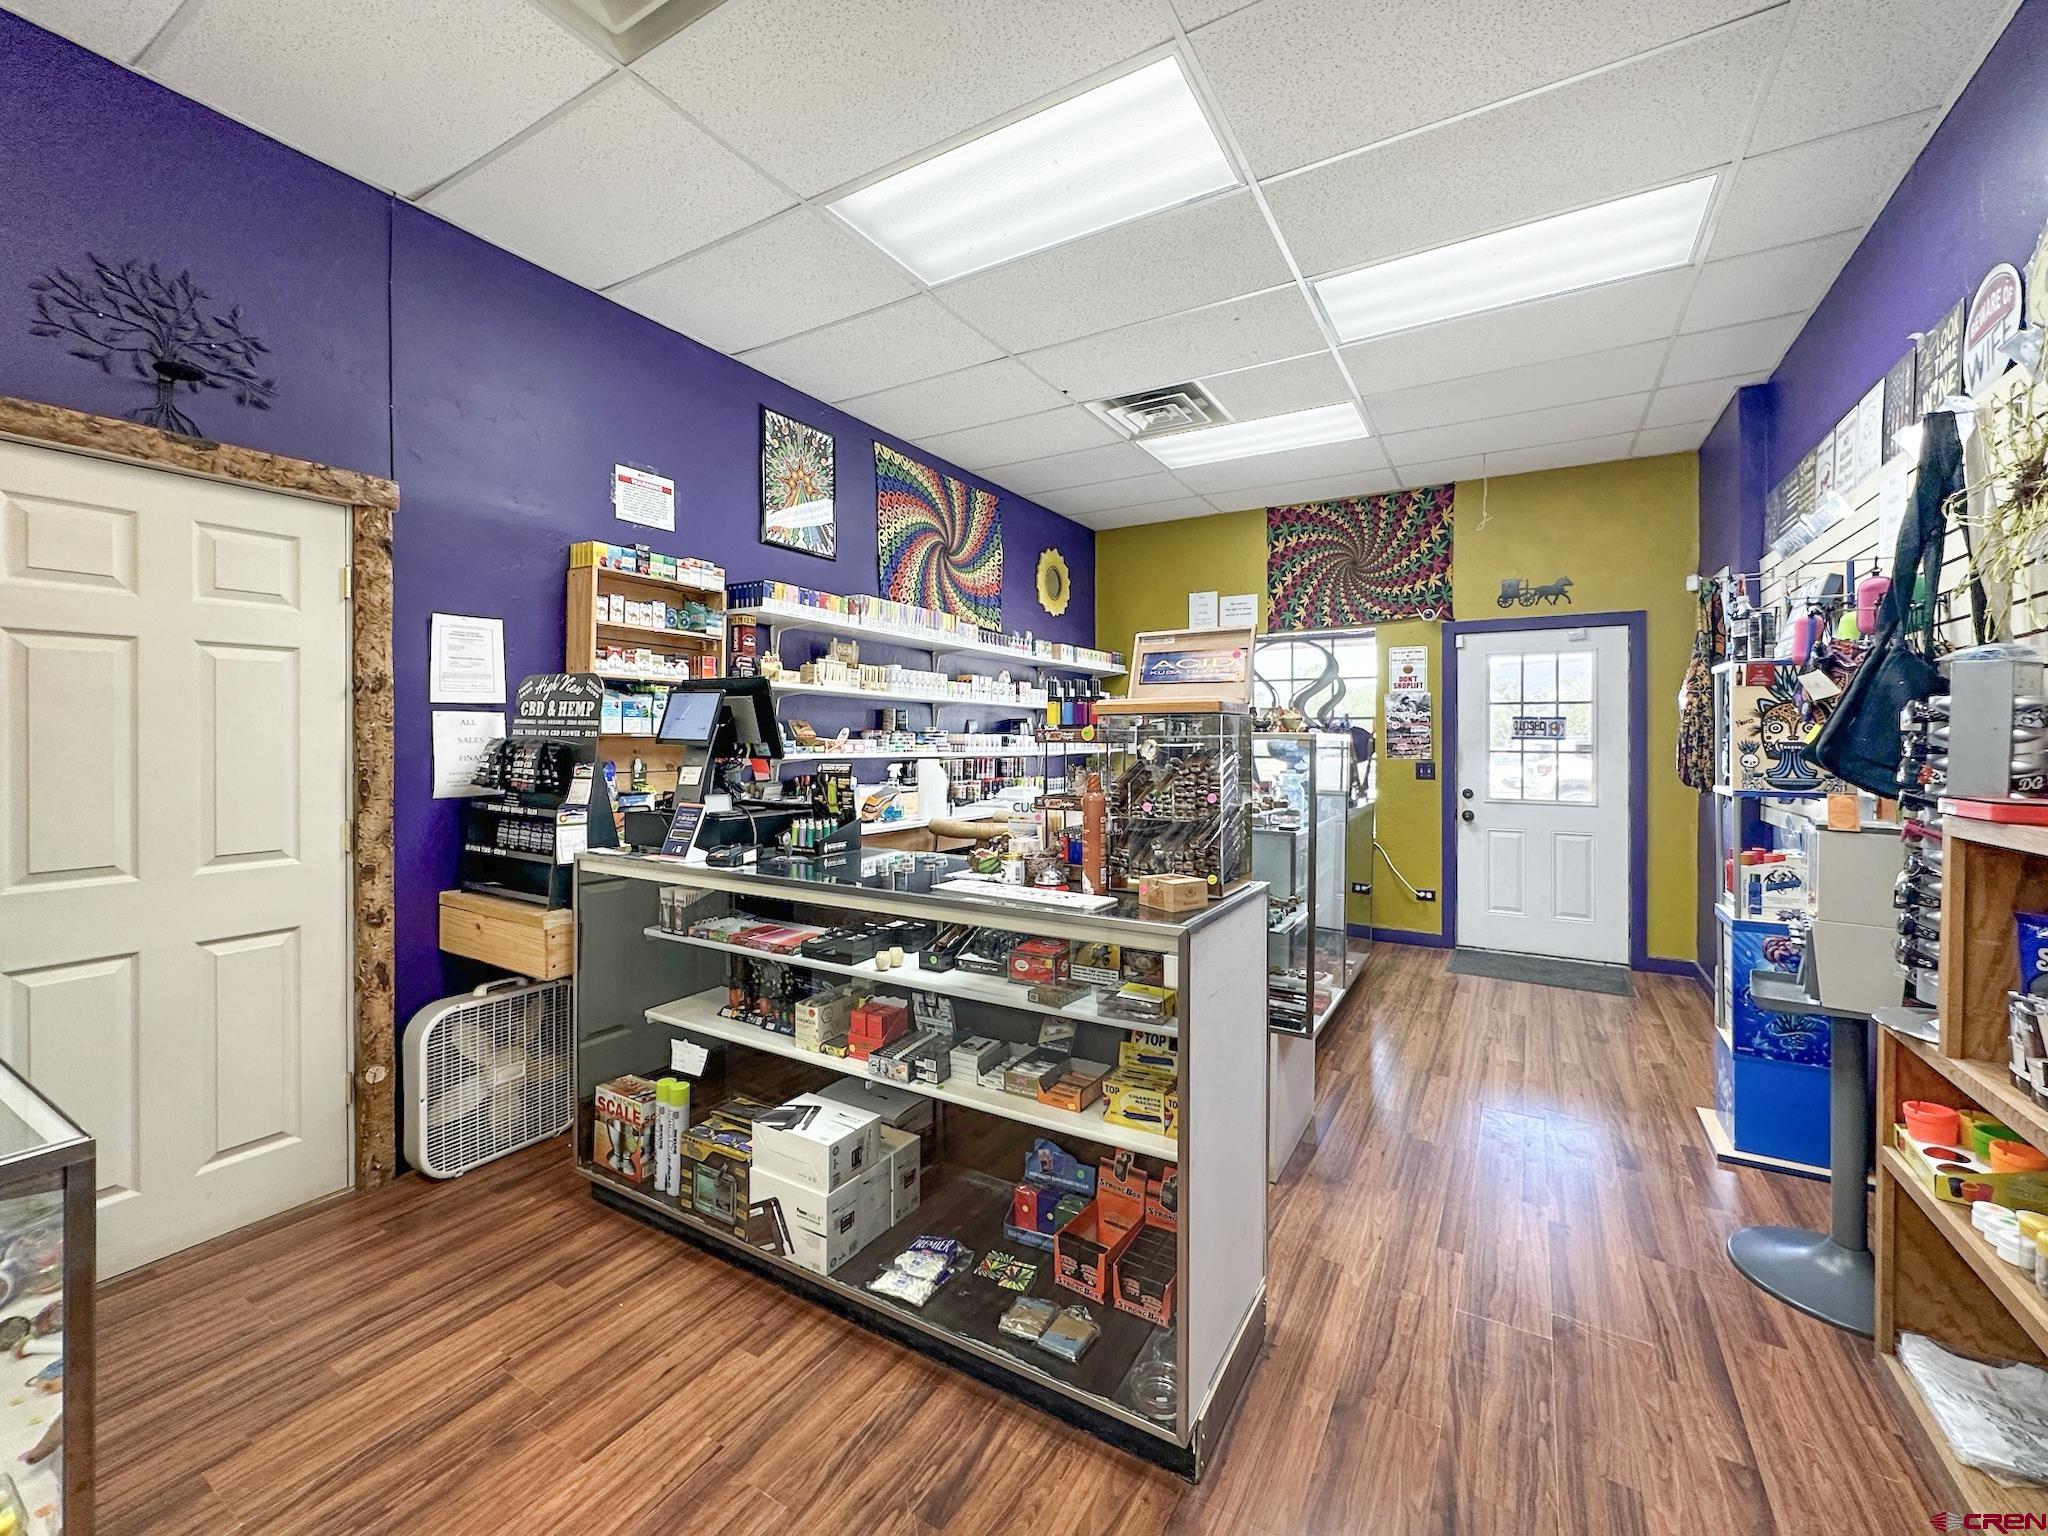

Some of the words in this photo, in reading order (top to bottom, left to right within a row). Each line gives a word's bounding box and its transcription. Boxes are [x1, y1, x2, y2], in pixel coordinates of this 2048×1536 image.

[1970, 287, 2002, 339] BEWARE
[2002, 284, 2015, 305] OF
[1151, 658, 1236, 671] ACID
[1393, 681, 1424, 690] SHOPLIFT
[1398, 675, 1418, 683] DON'T
[534, 674, 562, 701] High
[520, 700, 545, 717] CBD
[547, 700, 556, 717] &
[557, 700, 595, 717] HEMP
[1144, 1031, 1167, 1047] TOP
[1104, 1084, 1120, 1095] TOP
[597, 1095, 641, 1125] SCALE
[1168, 1098, 1178, 1109] TO
[908, 1238, 956, 1253] PREMIER
